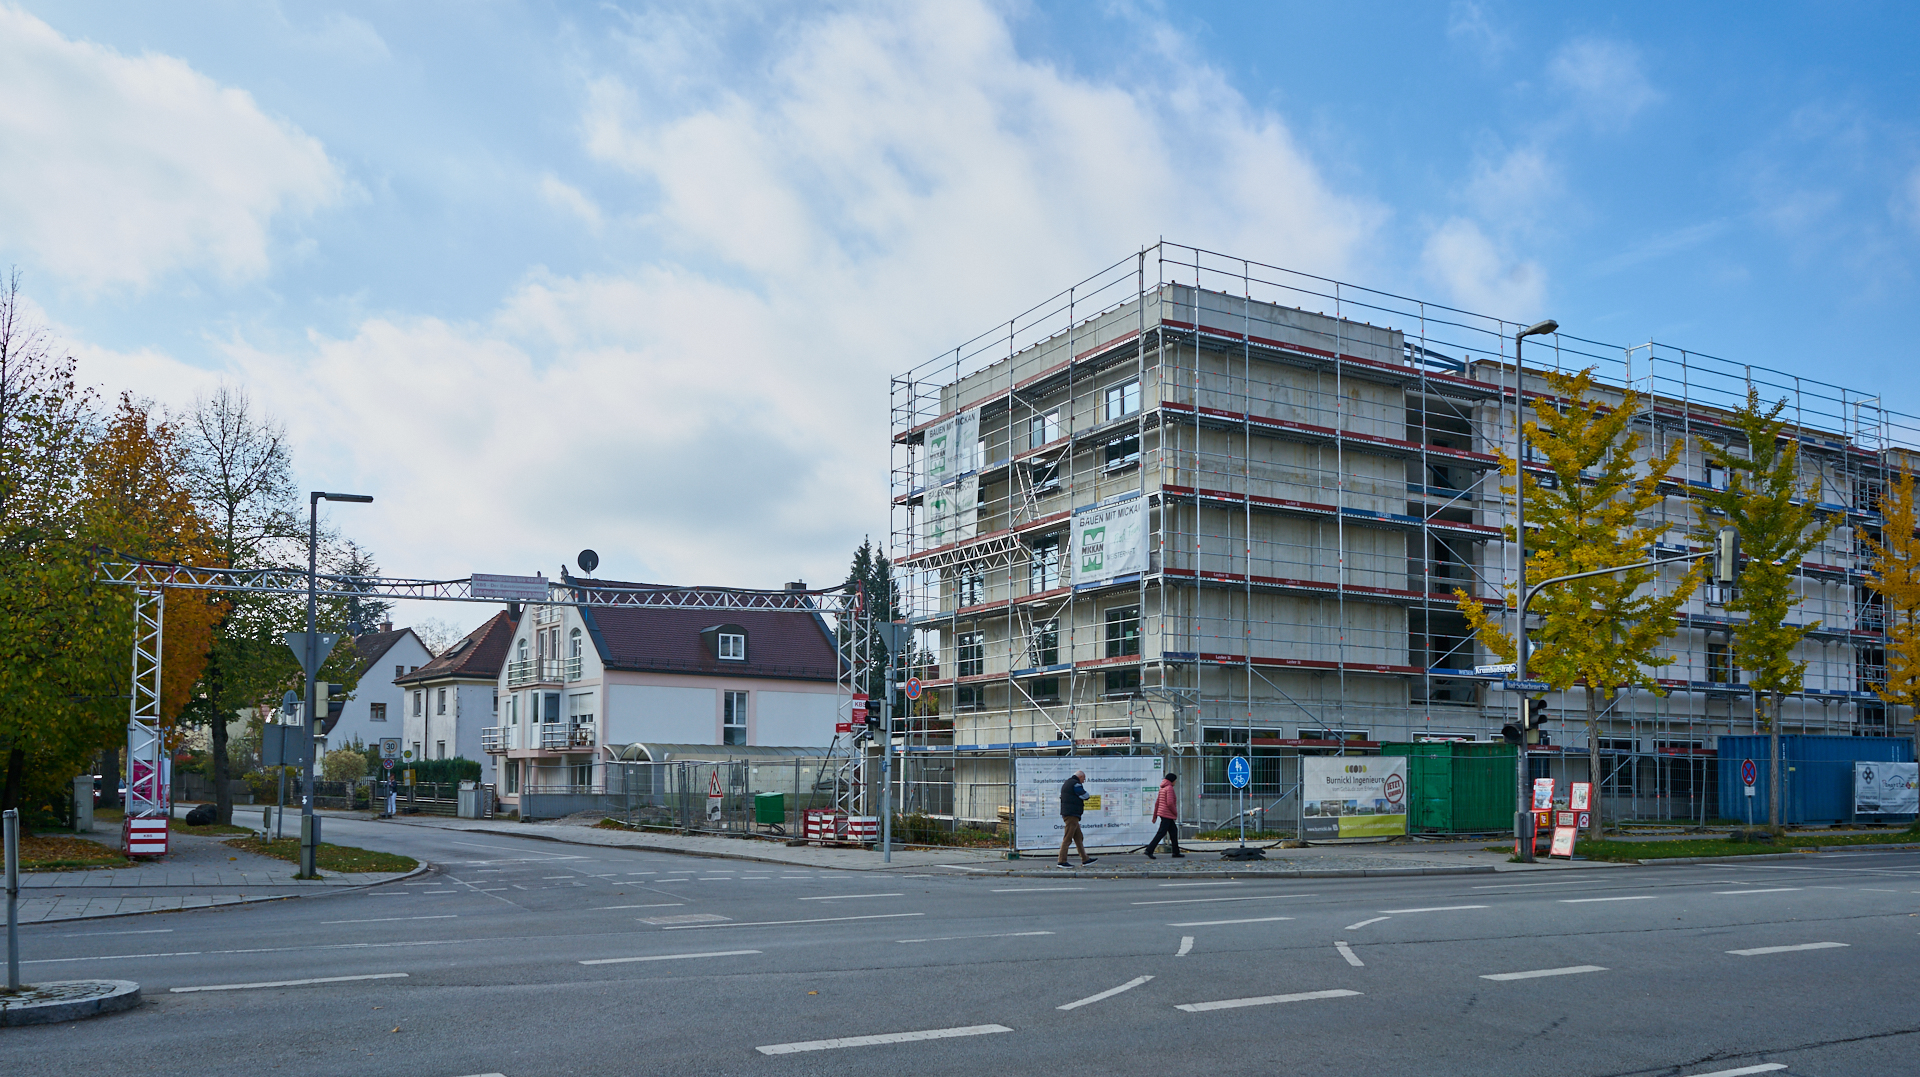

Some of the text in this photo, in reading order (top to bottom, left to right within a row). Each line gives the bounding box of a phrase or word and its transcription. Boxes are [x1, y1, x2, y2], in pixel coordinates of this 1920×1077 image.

[1079, 512, 1104, 527] BAUEN
[1105, 510, 1117, 522] MIT
[1475, 664, 1517, 675] Krumbadstraße
[1326, 775, 1386, 786] Burnickl Ingenieure
[1387, 780, 1401, 791] JETZT
